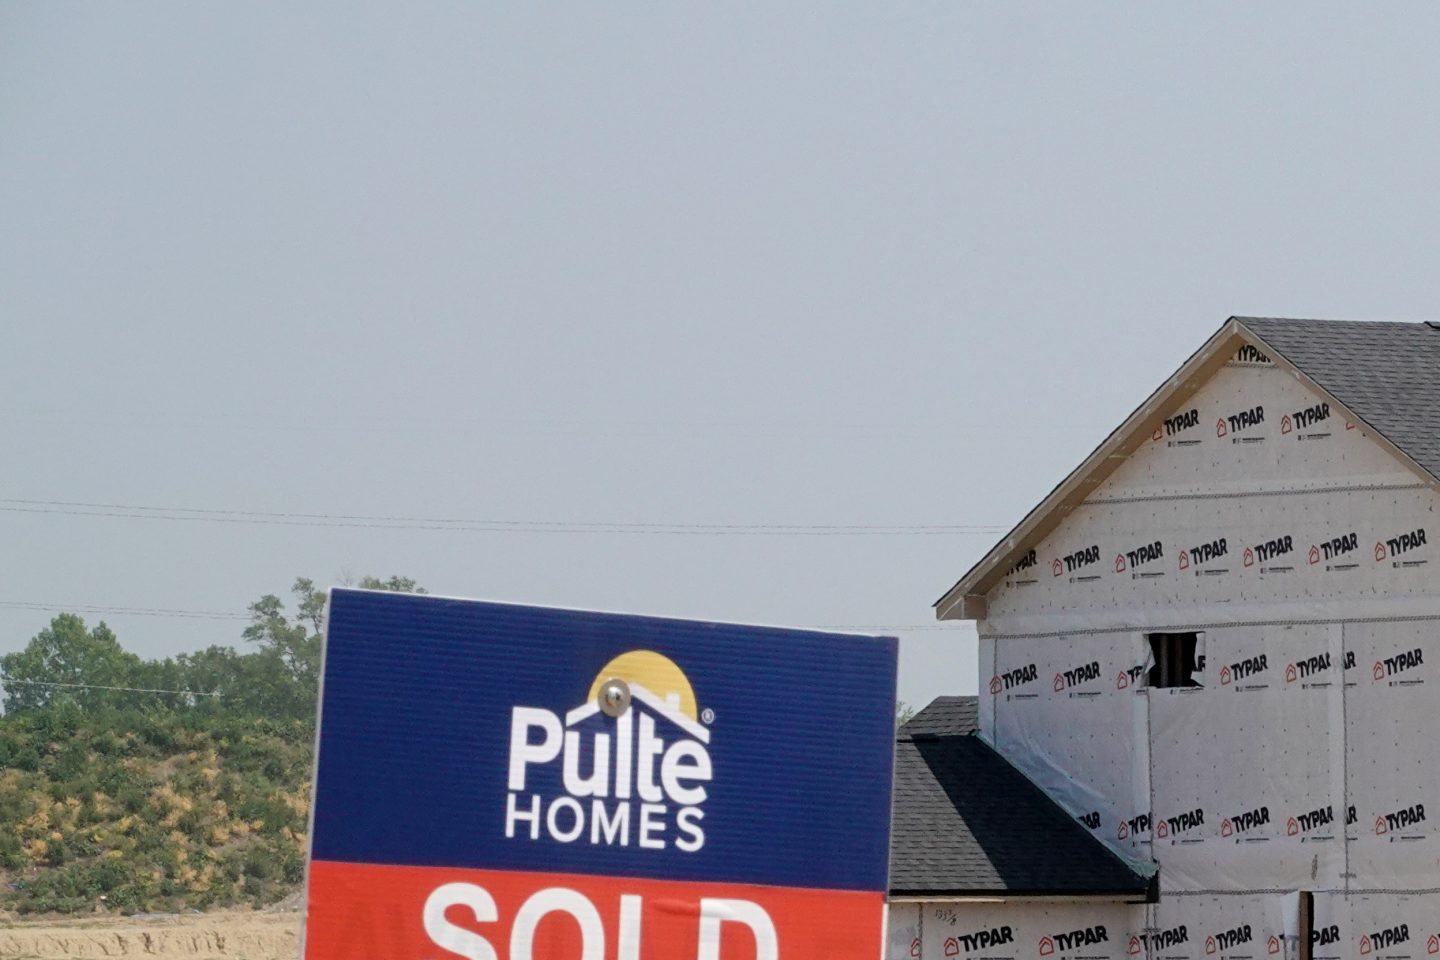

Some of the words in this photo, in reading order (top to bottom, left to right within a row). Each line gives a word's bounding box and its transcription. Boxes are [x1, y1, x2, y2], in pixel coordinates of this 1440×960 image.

[1164, 409, 1199, 436] TYPAR
[1228, 406, 1264, 432] TYPAR
[1292, 403, 1330, 429] TYPAR
[1127, 541, 1163, 568] TYPAR
[1190, 538, 1228, 565] TYPAR
[1254, 535, 1293, 562] TYPAR
[1321, 533, 1358, 560] TYPAR
[1386, 529, 1427, 556] TYPAR
[1063, 545, 1100, 572] TYPAR
[1063, 661, 1101, 687] TYPAR
[1230, 654, 1268, 681] TYPAR
[1384, 648, 1424, 676] TYPAR
[1002, 664, 1038, 690] TYPAR
[508, 704, 713, 806] Pulte
[505, 792, 705, 852] HOMES
[1167, 808, 1204, 835] TYPAR
[1231, 806, 1270, 834] TYPAR
[1385, 804, 1426, 831] TYPAR
[958, 925, 1014, 952] TYPAR
[1053, 925, 1109, 952] TYPAR
[1216, 925, 1252, 951] TYPAR
[1312, 925, 1340, 947] PAR
[1370, 924, 1409, 951] TYPAR
